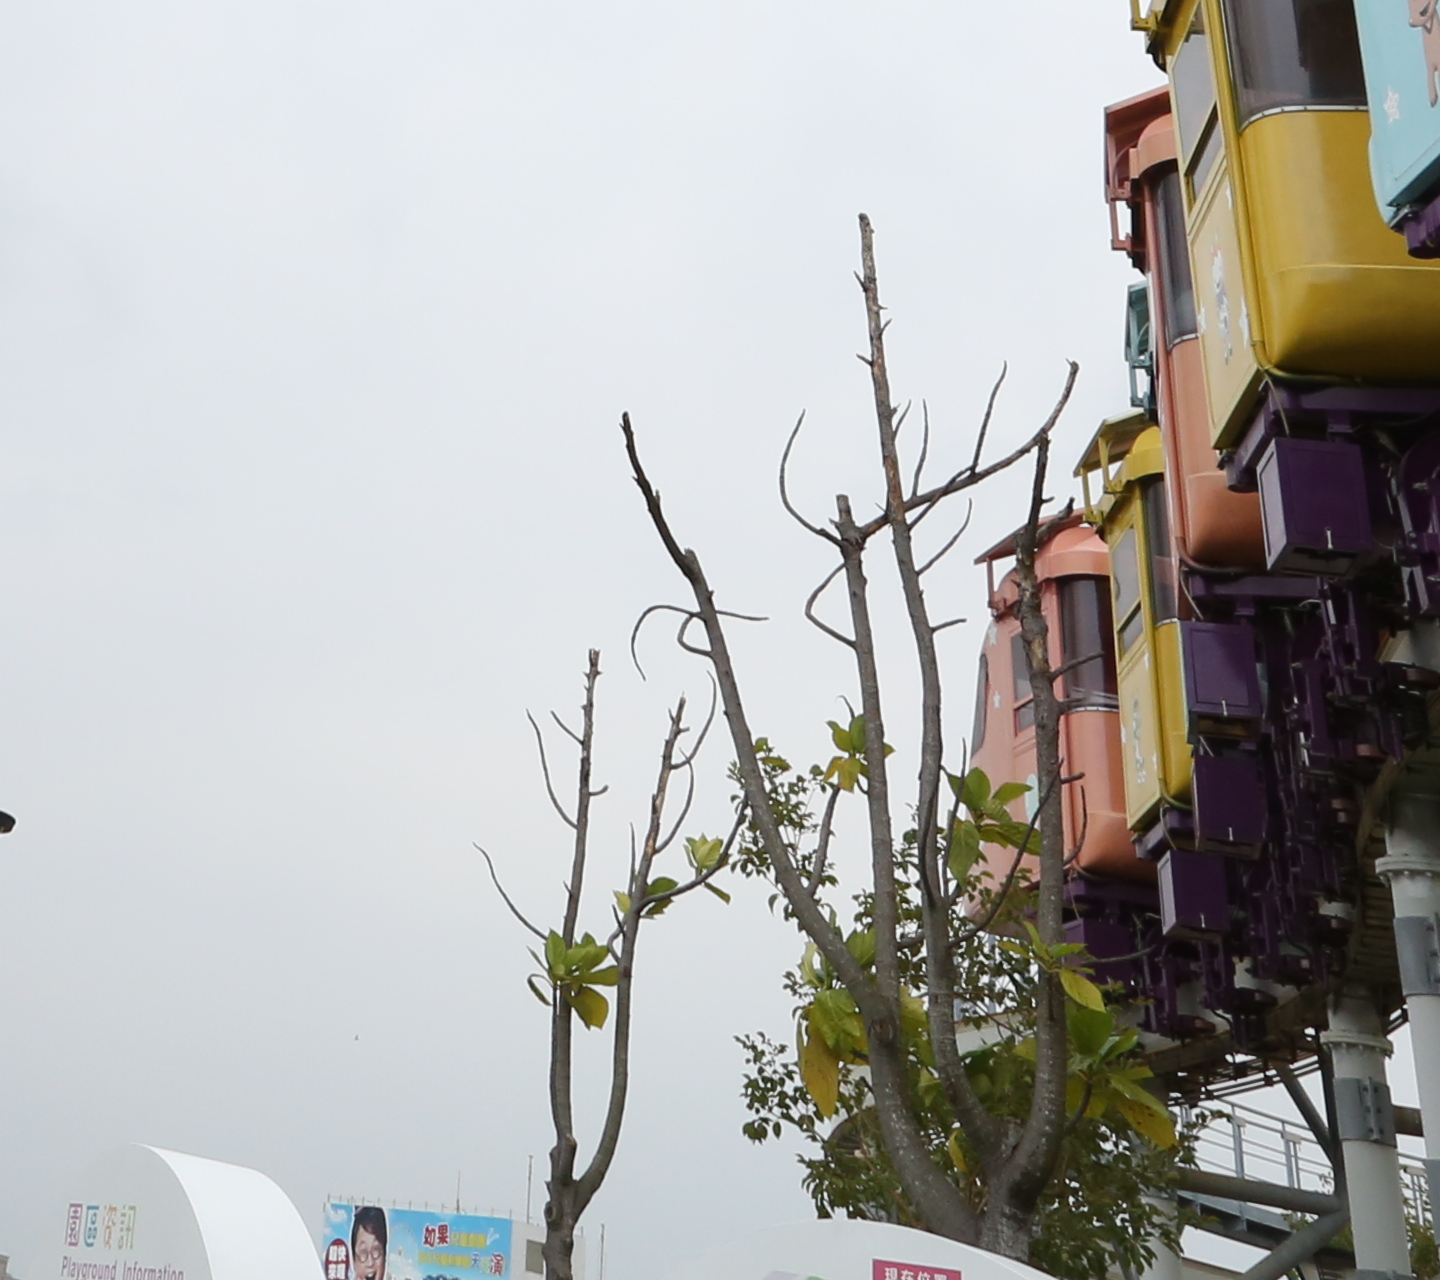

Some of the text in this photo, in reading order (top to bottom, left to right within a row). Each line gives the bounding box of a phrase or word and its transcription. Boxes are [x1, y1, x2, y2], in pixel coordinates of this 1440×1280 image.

[64, 1203, 137, 1251] 園區資訊
[61, 1256, 185, 1280] Playground Information
